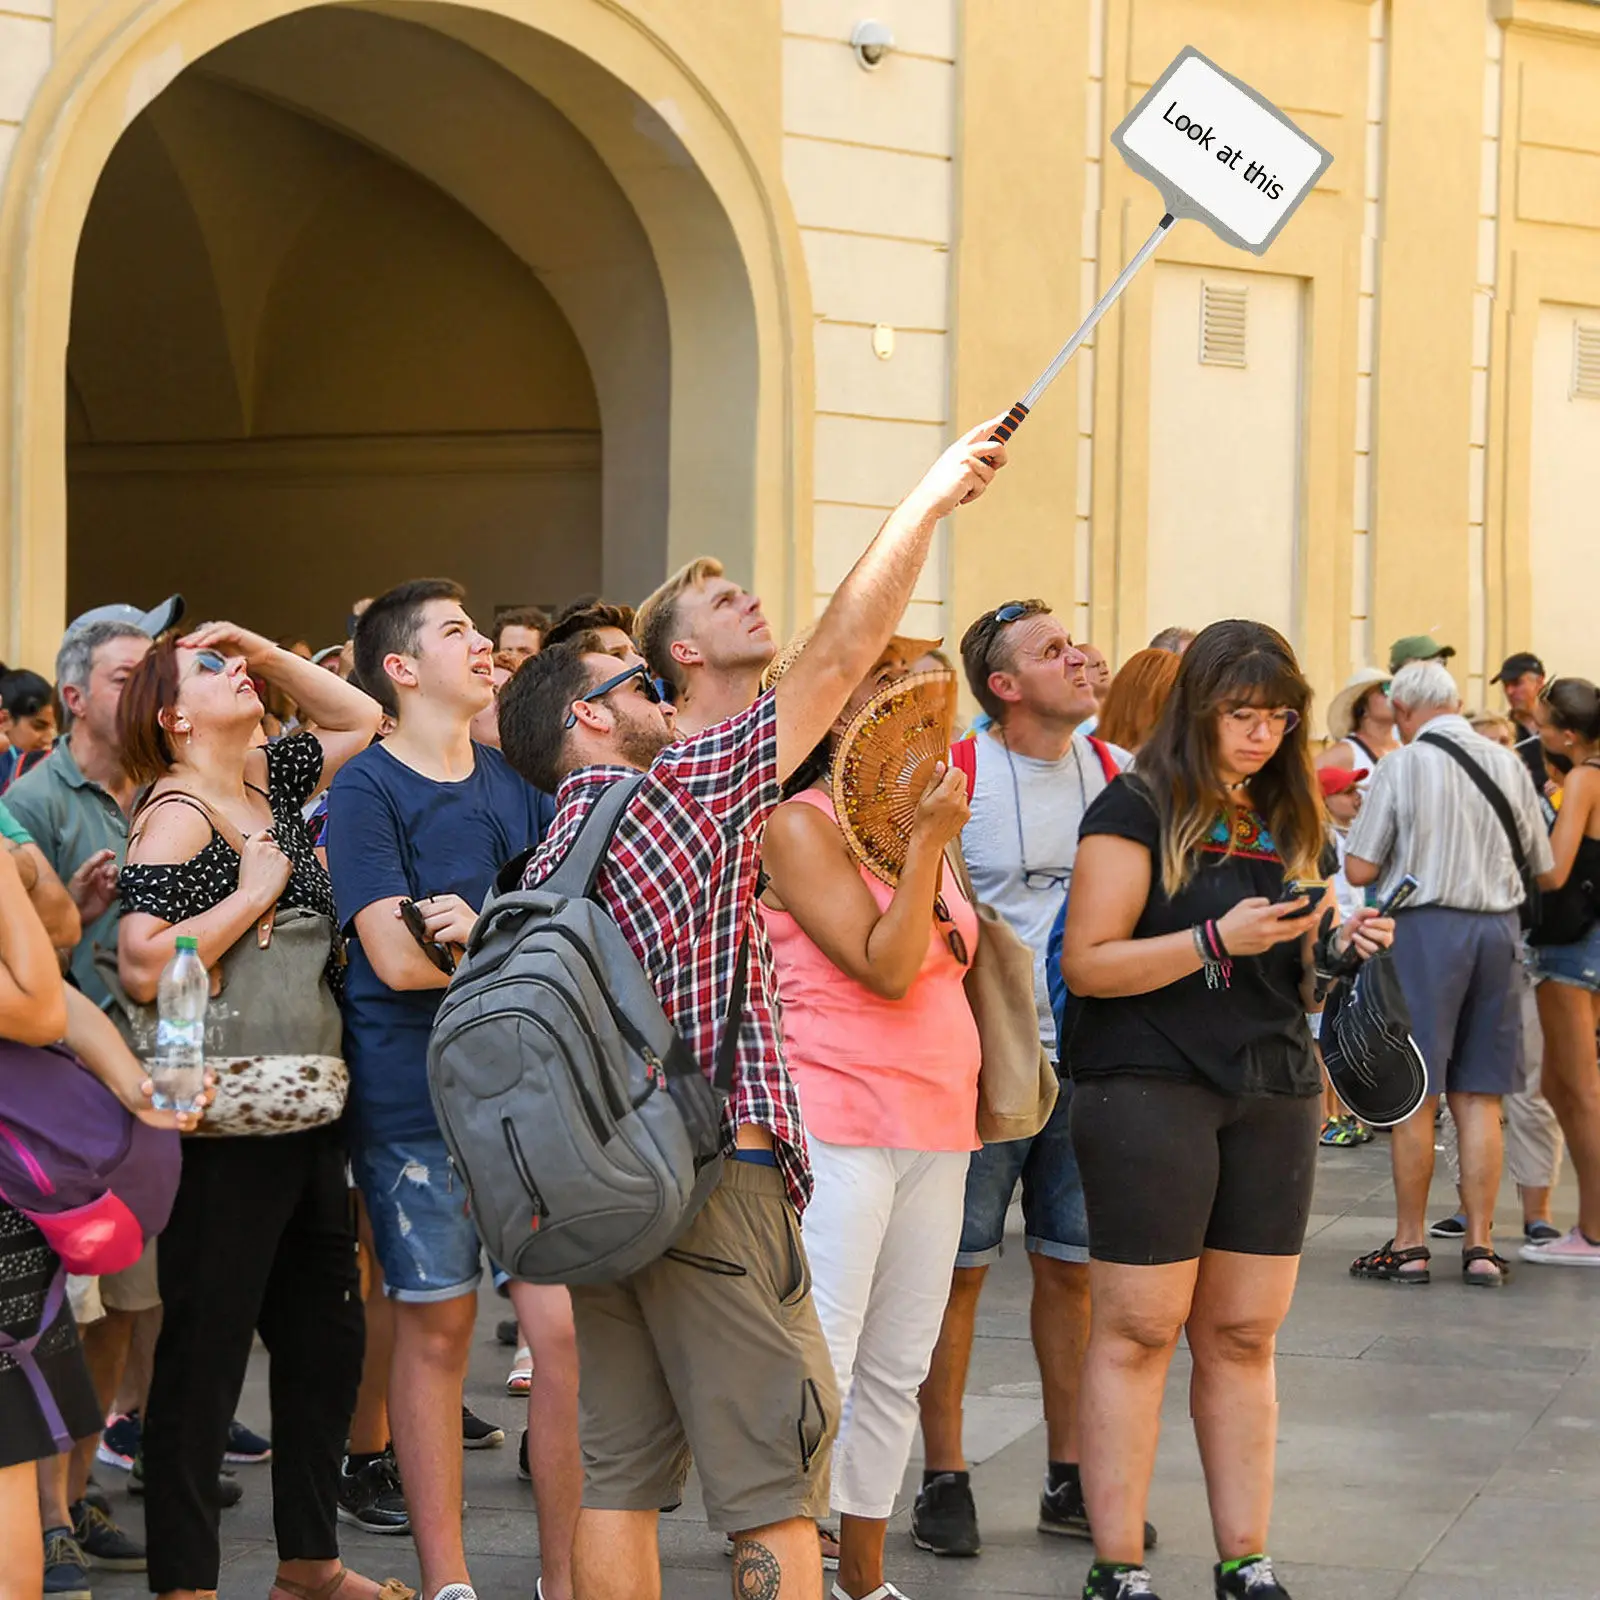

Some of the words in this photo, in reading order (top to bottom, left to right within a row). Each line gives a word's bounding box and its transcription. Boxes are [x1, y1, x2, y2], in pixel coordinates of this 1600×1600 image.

[1162, 101, 1217, 151] Look
[1216, 145, 1244, 171] at
[1243, 160, 1284, 200] this
